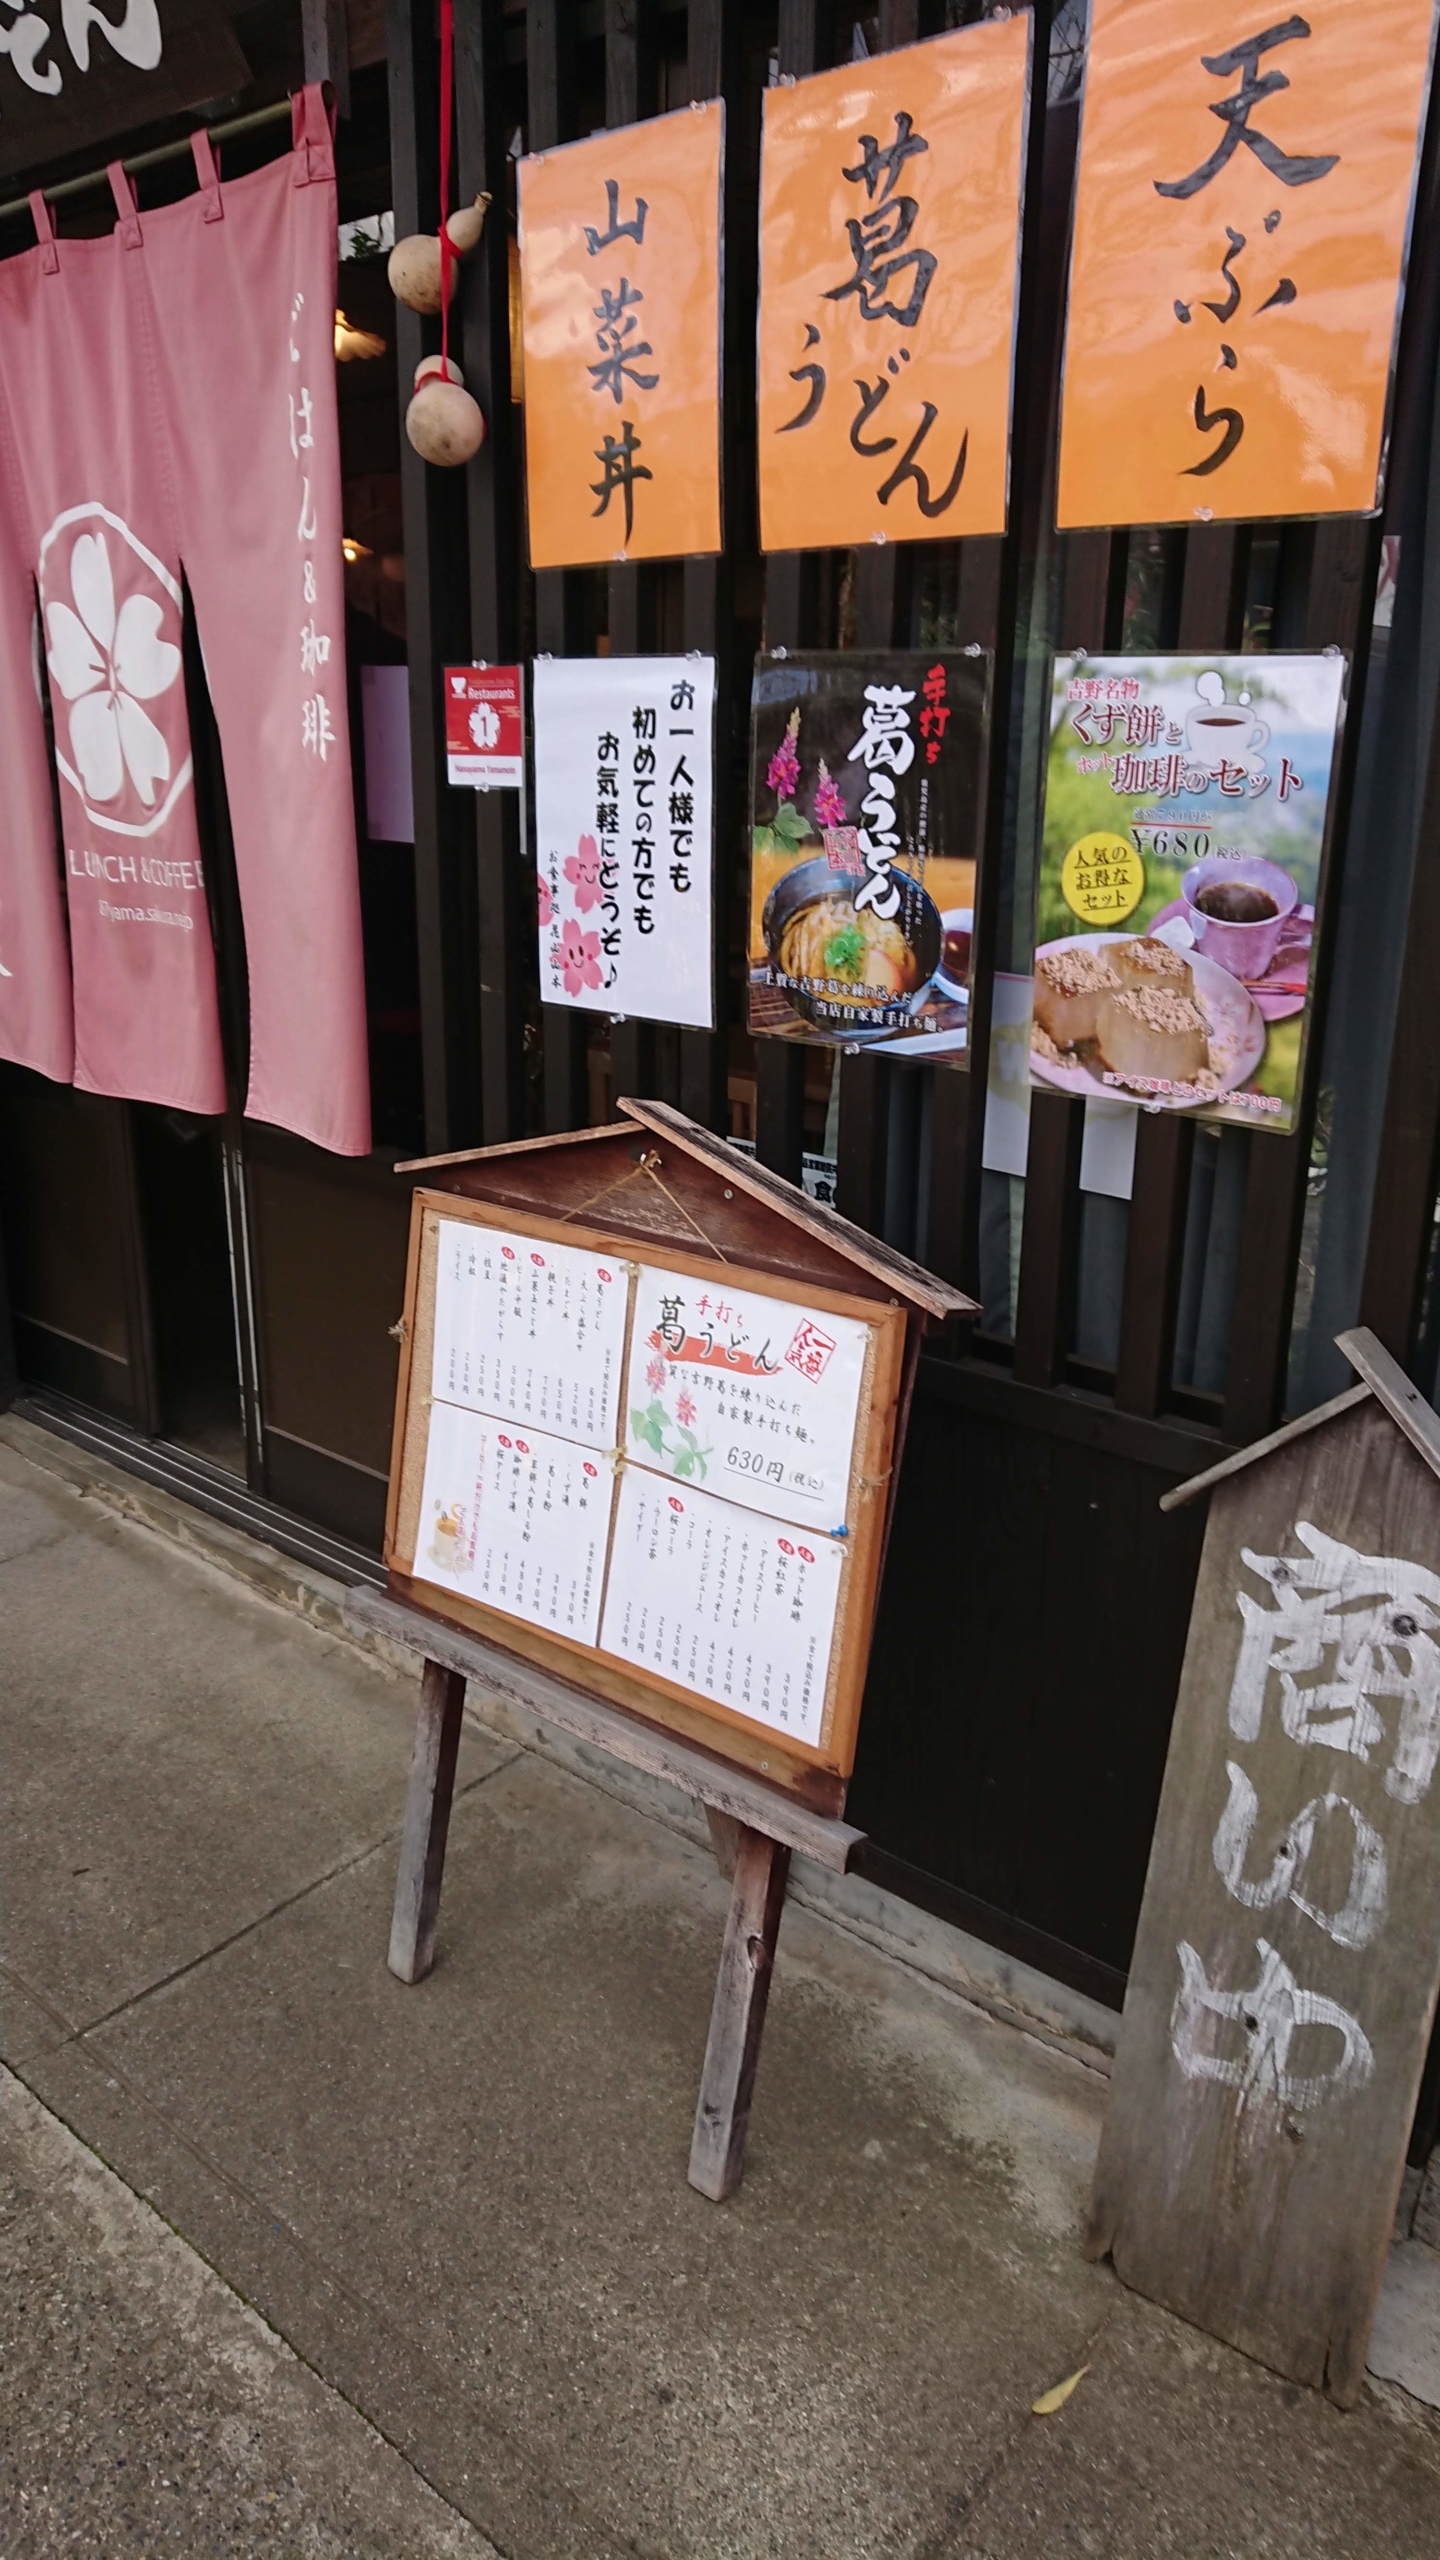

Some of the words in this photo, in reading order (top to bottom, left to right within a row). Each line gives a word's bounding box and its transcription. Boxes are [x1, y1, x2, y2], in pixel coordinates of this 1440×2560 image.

[1152, 13, 1341, 477] 天ぷら
[774, 111, 968, 519] 葛うどん
[583, 178, 660, 547] 山菜丼
[468, 687, 515, 700] Restaurants
[1067, 676, 1141, 700] 吉野名物
[919, 663, 950, 765] 手打ち
[1070, 702, 1183, 745] くず餅と
[668, 679, 695, 893] お一人様でも
[848, 684, 917, 920] 葛うどん
[632, 705, 657, 935] 初めての方でも
[68, 849, 138, 883] LUNCH
[1074, 847, 1128, 867] 人気の
[1075, 867, 1129, 891] お得な
[1082, 889, 1126, 908] セット
[694, 1294, 744, 1328] 手打ち
[655, 1294, 782, 1373] 葛うどん
[570, 1382, 579, 1427] 520円
[586, 1387, 594, 1431] 630円
[727, 1446, 784, 1483] 630円
